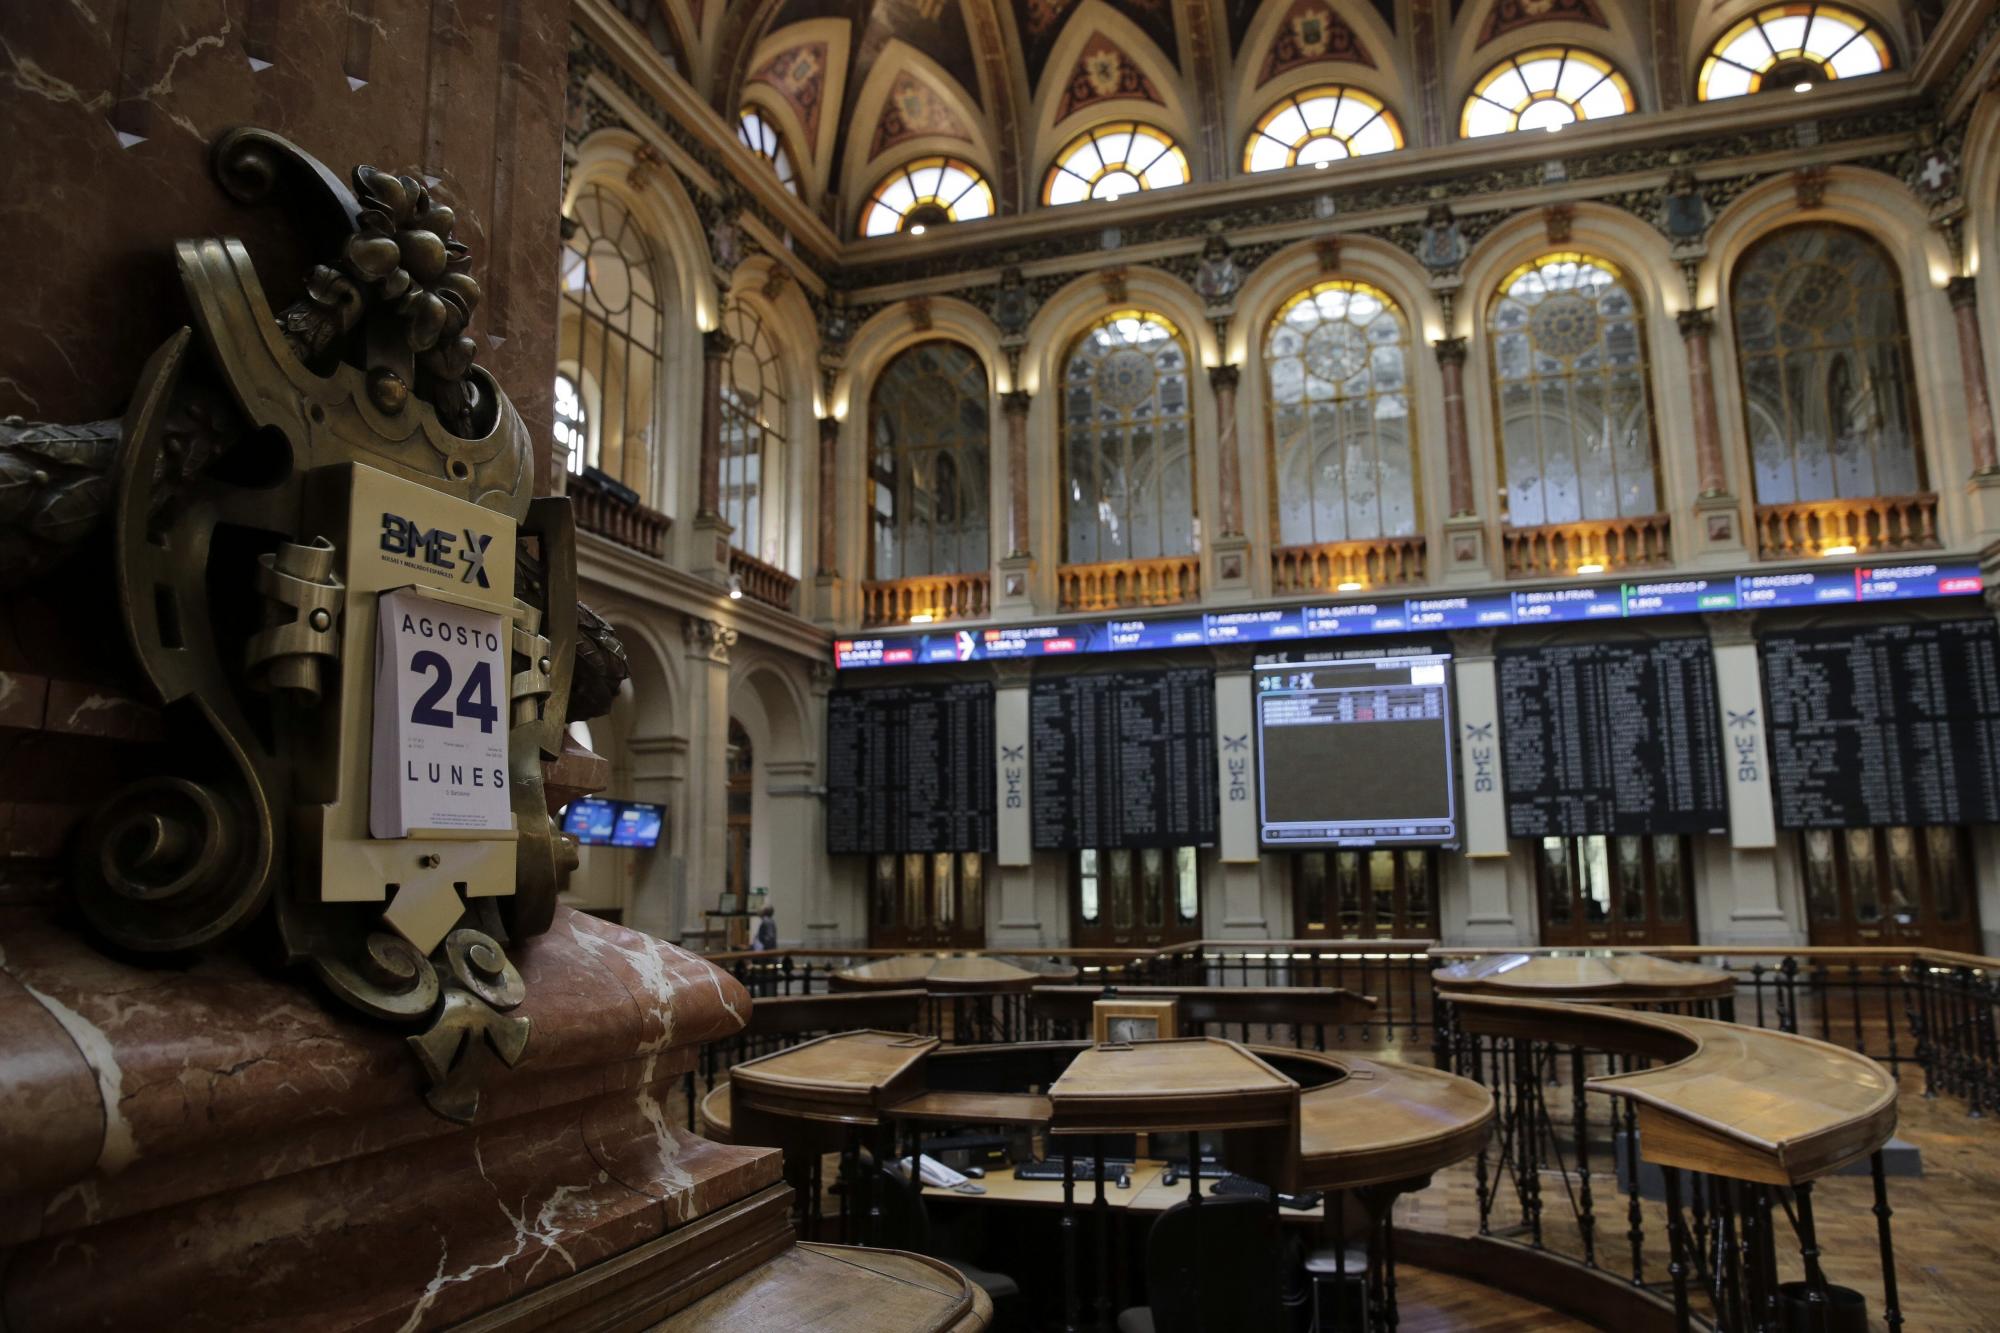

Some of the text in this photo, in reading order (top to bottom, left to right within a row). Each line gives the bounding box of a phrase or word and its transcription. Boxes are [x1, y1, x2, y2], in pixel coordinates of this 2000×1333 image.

[402, 614, 498, 652] AGOSTO
[410, 650, 498, 734] 24
[408, 760, 504, 788] LUNES
